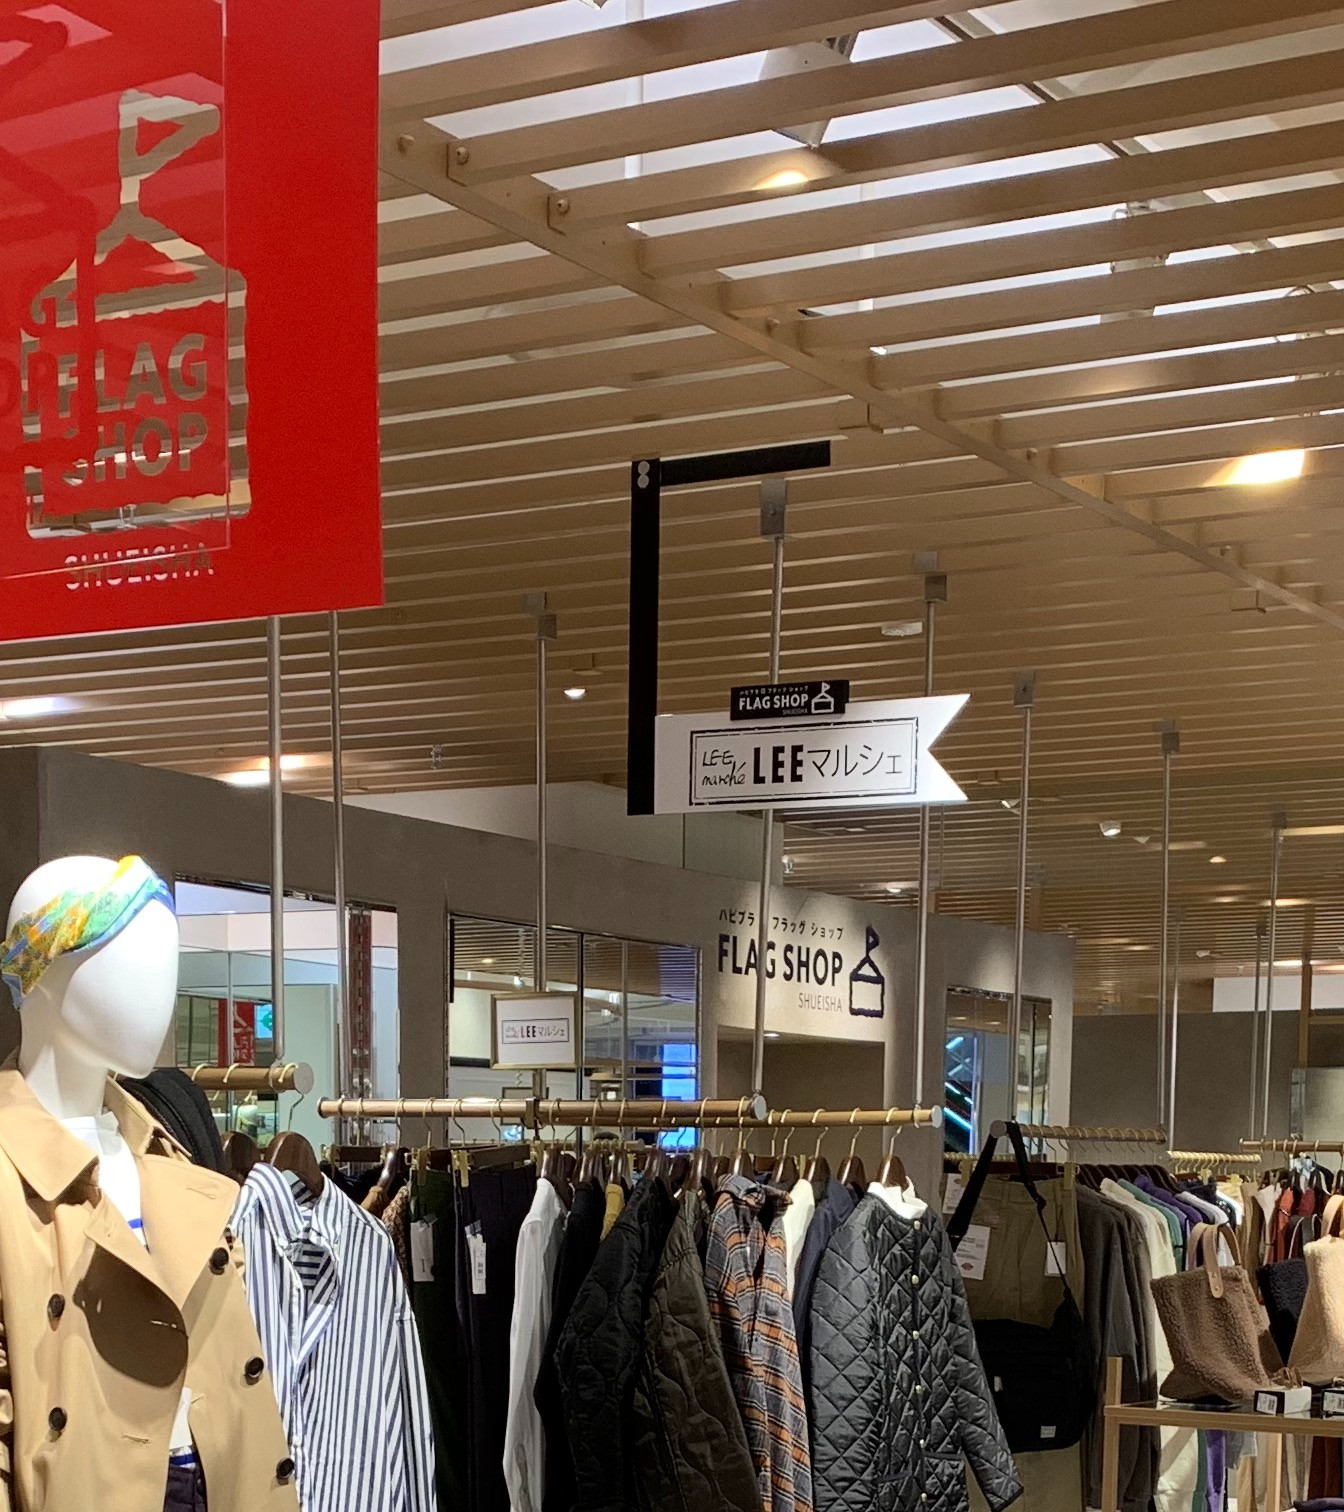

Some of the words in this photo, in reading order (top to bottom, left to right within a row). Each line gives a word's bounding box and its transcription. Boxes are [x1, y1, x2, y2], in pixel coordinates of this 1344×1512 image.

[64, 542, 216, 590] SHUEISHA
[738, 695, 771, 711] FLAG
[773, 693, 809, 709] SHOP
[718, 933, 777, 979] FLAG
[783, 943, 844, 987] SHOP
[798, 992, 843, 1018] SHUEISHA
